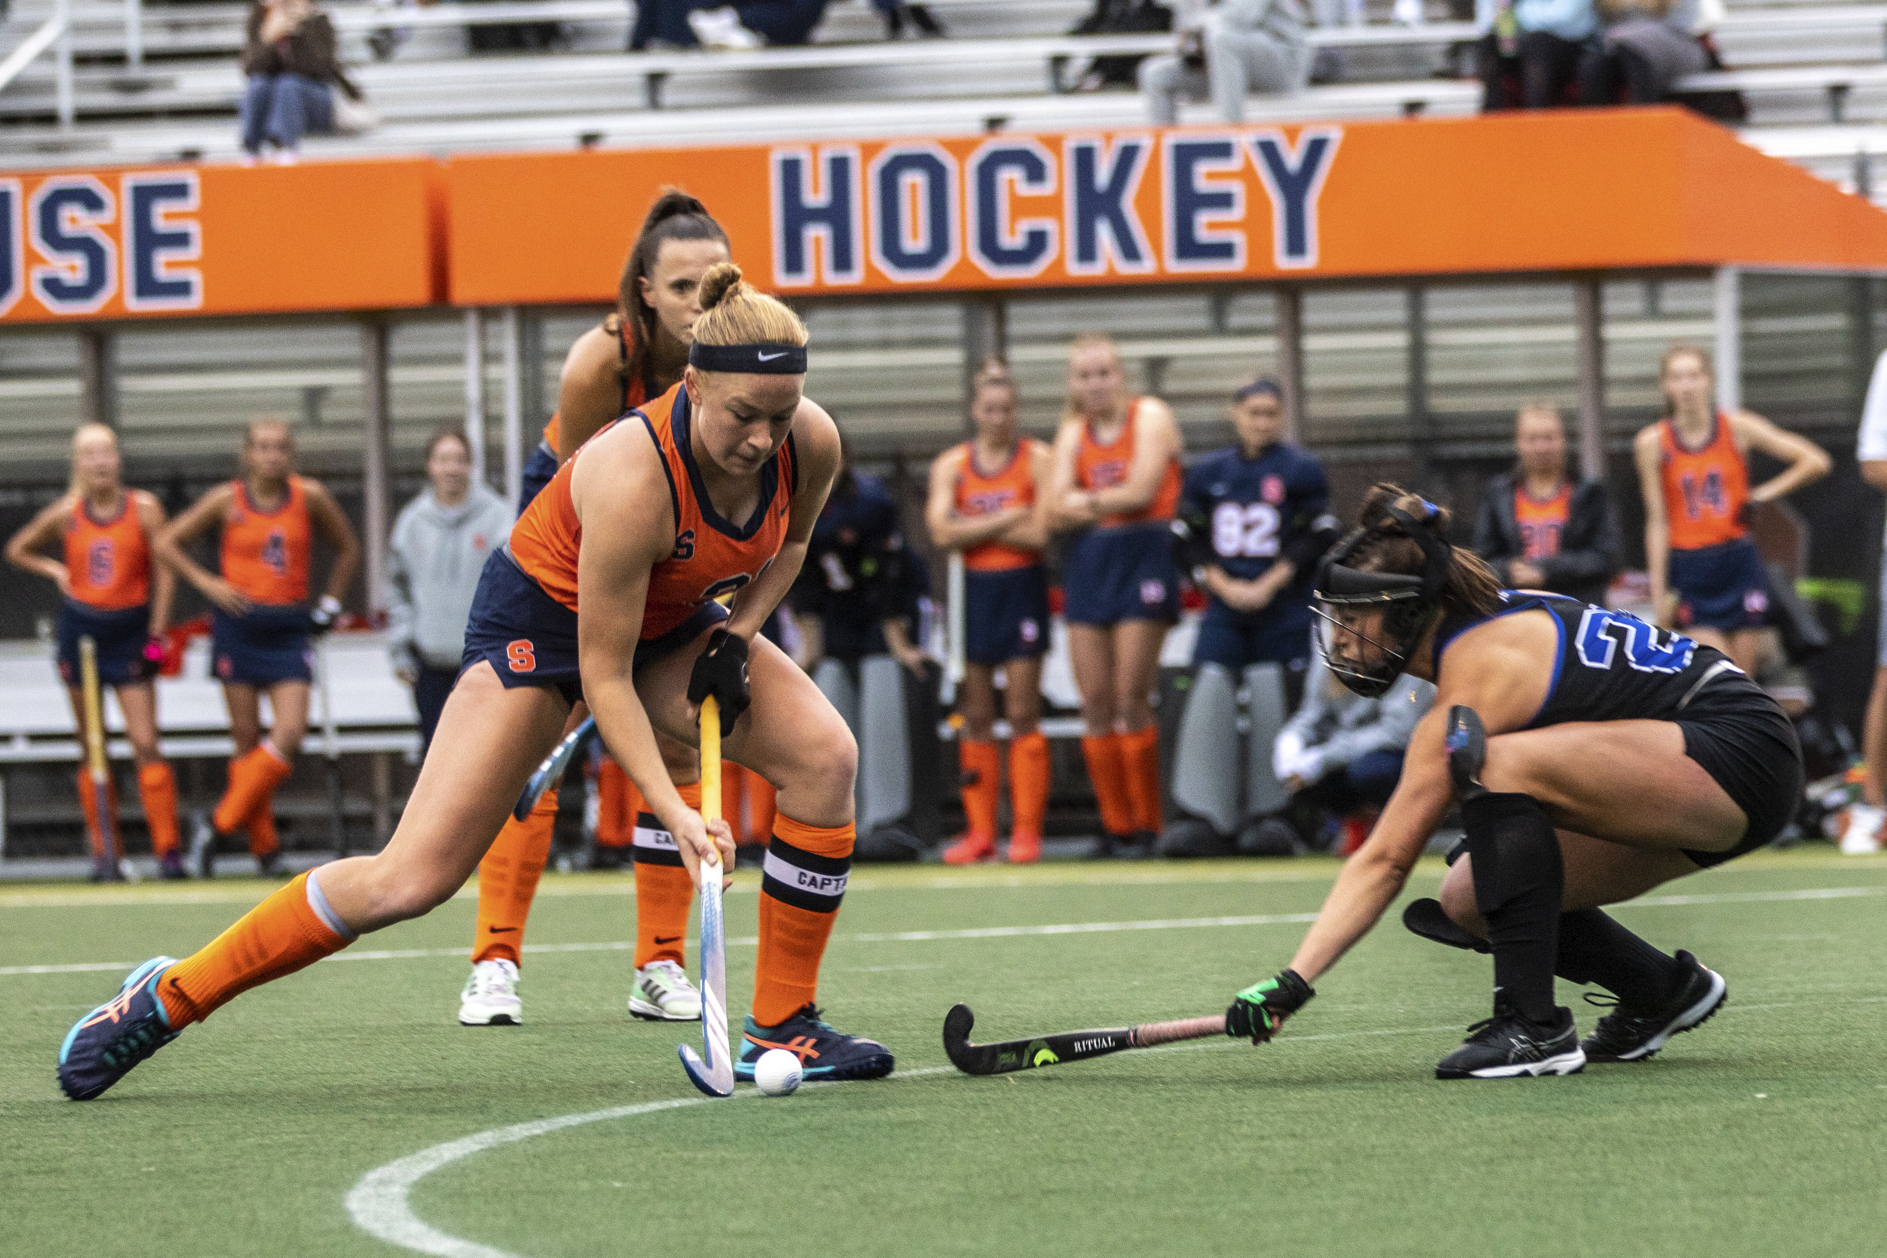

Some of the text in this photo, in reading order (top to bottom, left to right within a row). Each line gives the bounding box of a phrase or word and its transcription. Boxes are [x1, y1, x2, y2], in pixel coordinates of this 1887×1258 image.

[770, 124, 1344, 288] HOCKEY
[0, 171, 203, 316] SE
[671, 528, 696, 562] S
[1212, 502, 1280, 557] 82
[506, 639, 537, 673] S
[1073, 1035, 1117, 1054] RITUAL
